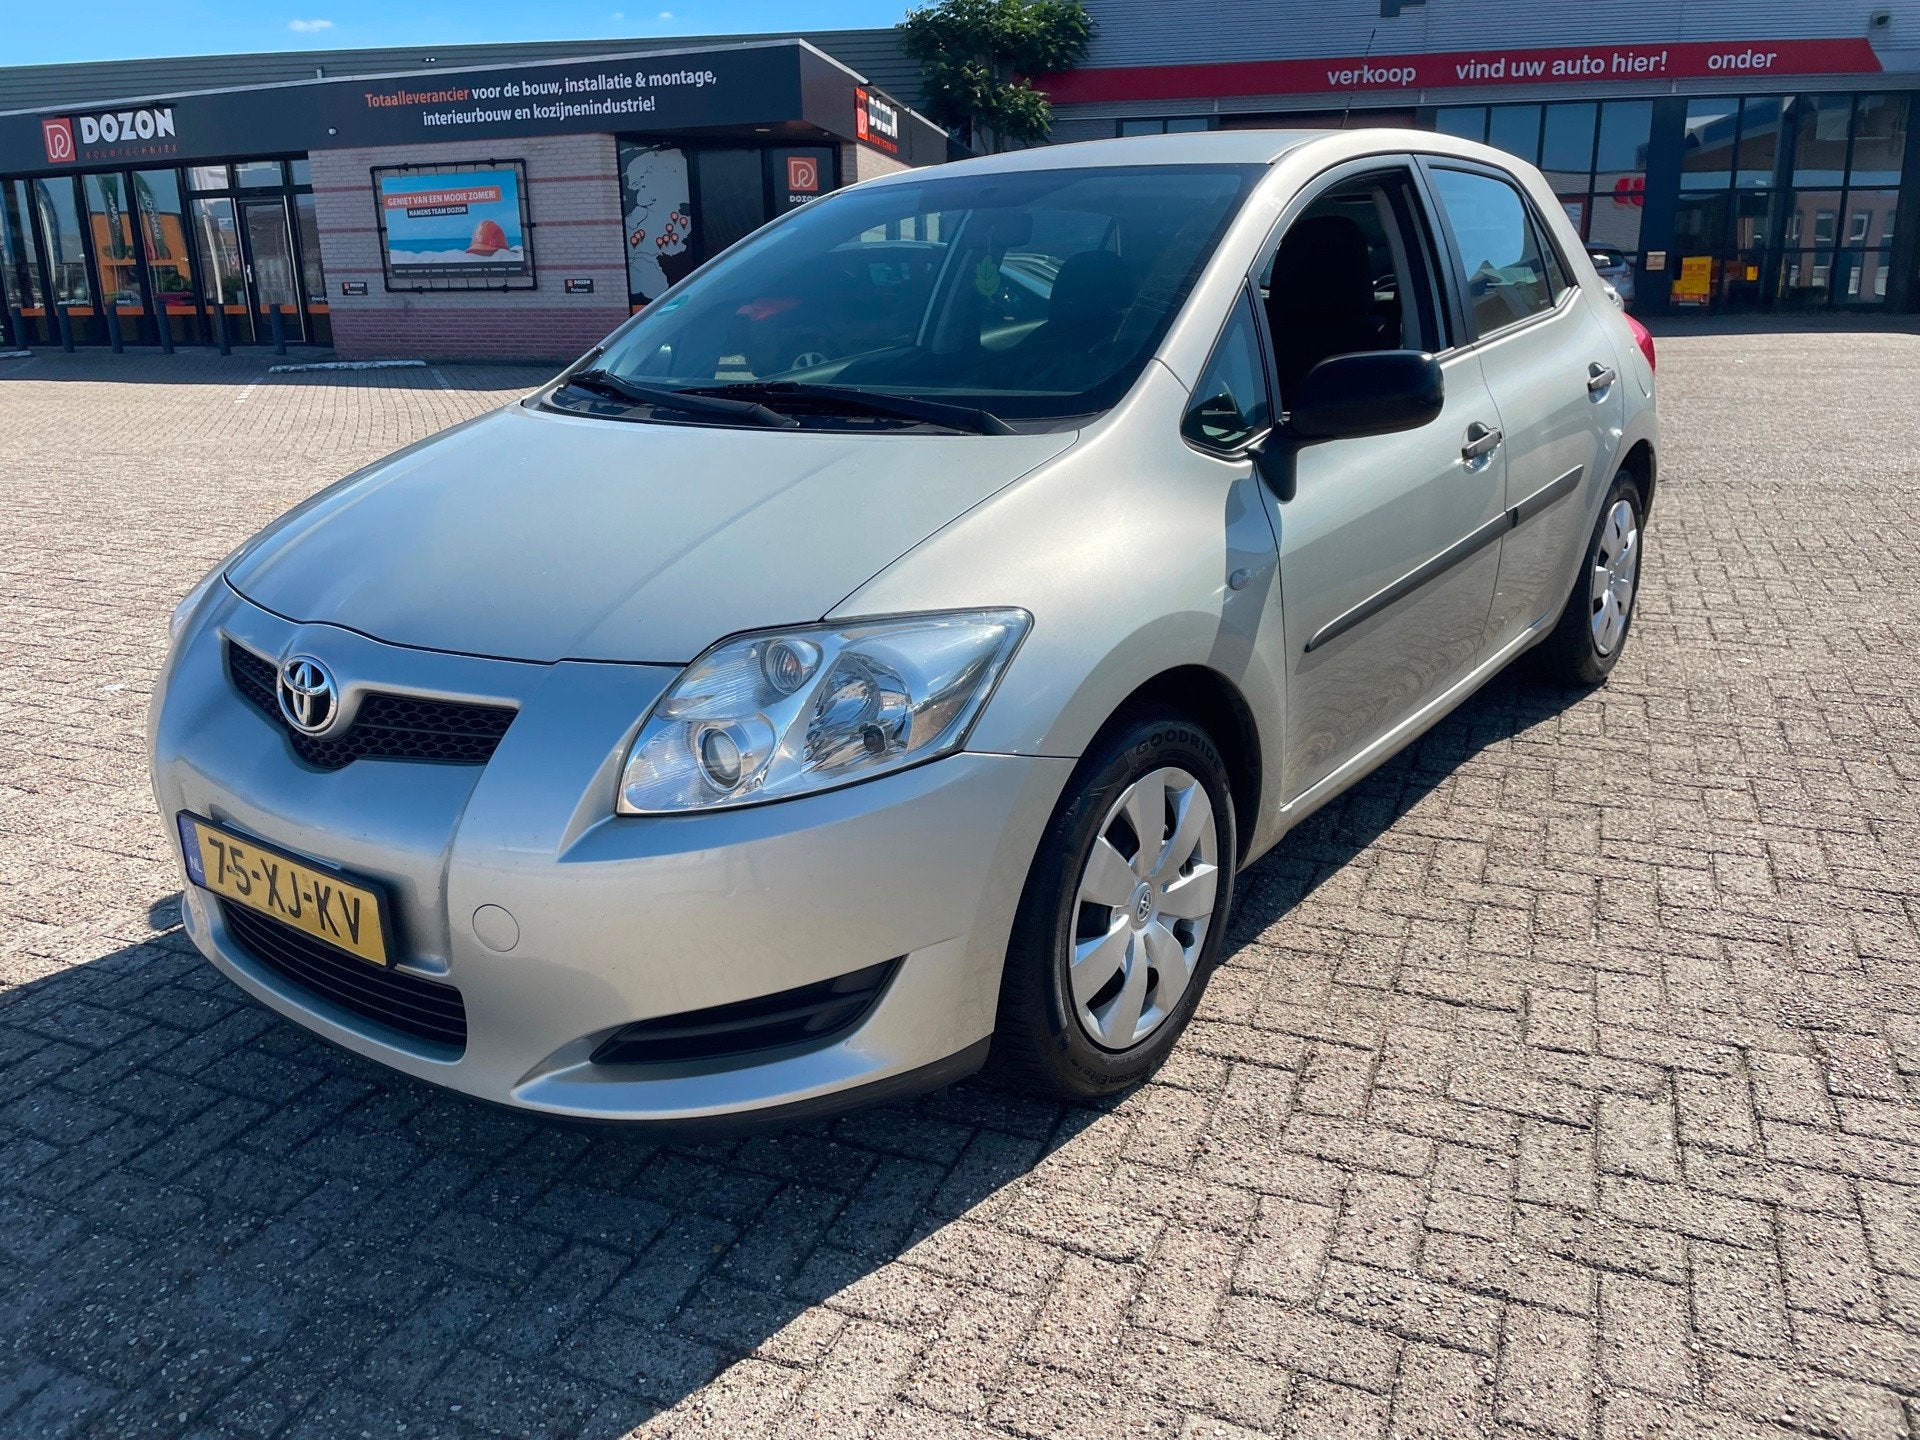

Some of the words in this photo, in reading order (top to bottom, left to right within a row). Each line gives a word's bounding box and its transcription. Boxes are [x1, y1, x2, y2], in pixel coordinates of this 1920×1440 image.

[1455, 58, 1505, 80] vind
[1510, 60, 1546, 77] uw
[1551, 54, 1605, 76] auto
[1611, 50, 1667, 73] hier!
[1707, 49, 1777, 70] onder
[365, 87, 470, 108] Totaalleverancier
[471, 85, 501, 100] voor
[503, 83, 520, 98] de
[522, 80, 563, 96] bouw,
[565, 73, 633, 93] installatie
[635, 71, 647, 88] &
[648, 70, 717, 88] montage,
[1327, 64, 1417, 86] verkoop
[79, 108, 176, 144] DOZON
[423, 107, 512, 126] interieurbouw
[514, 107, 531, 120] en
[533, 96, 656, 121] kozijnenindustrie!
[868, 95, 898, 139] DOZON
[387, 196, 412, 206] GENIET
[413, 195, 428, 205] VAN
[429, 194, 442, 203] EEN
[443, 192, 468, 202] MOOIE
[468, 190, 496, 200] ZOMER!
[409, 208, 432, 217] NAMENS
[432, 207, 446, 215] TEAM
[447, 206, 467, 214] DOZON
[1136, 729, 1222, 775] GOODRIDE
[189, 855, 203, 874] NL
[208, 837, 360, 945] 75-XJ-KV
